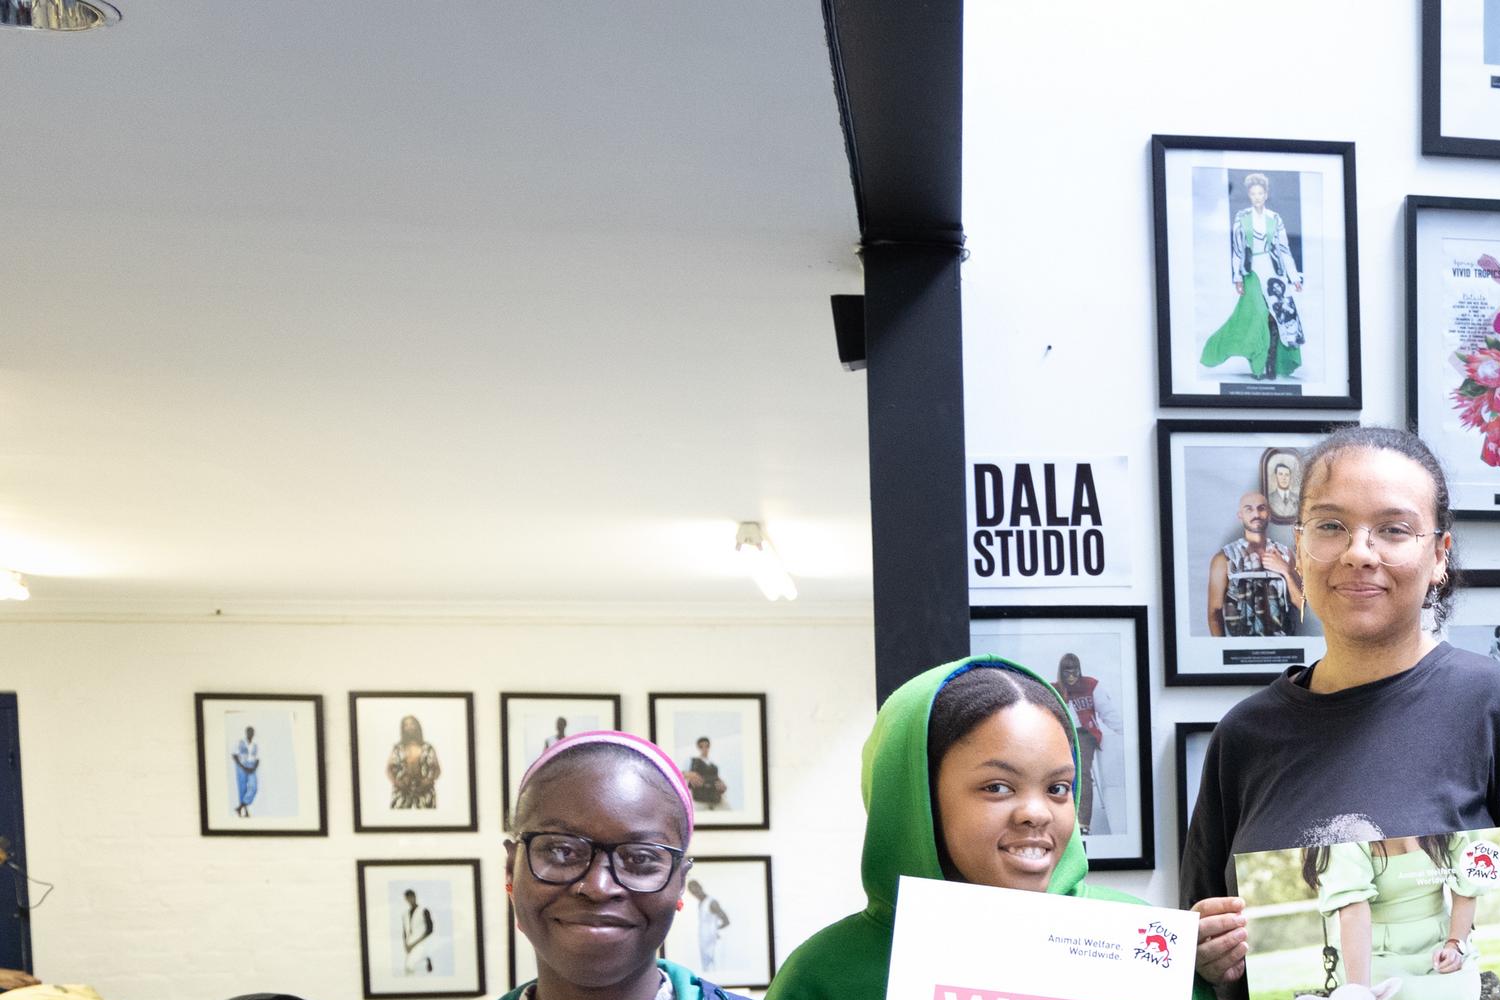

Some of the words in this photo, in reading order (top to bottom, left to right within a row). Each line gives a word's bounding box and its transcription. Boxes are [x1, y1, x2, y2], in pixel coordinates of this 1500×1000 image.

[1452, 268, 1470, 278] VIVID
[974, 462, 1102, 528] DALA
[973, 528, 1105, 577] STUDIO
[1474, 843, 1499, 859] FOUR
[1466, 868, 1498, 879] PAWS
[1149, 921, 1177, 944] FOUR
[1048, 934, 1081, 945] Animal
[1084, 939, 1123, 951] Welfare.
[1069, 947, 1122, 960] Worldwide.
[1134, 948, 1172, 968] PAWS
